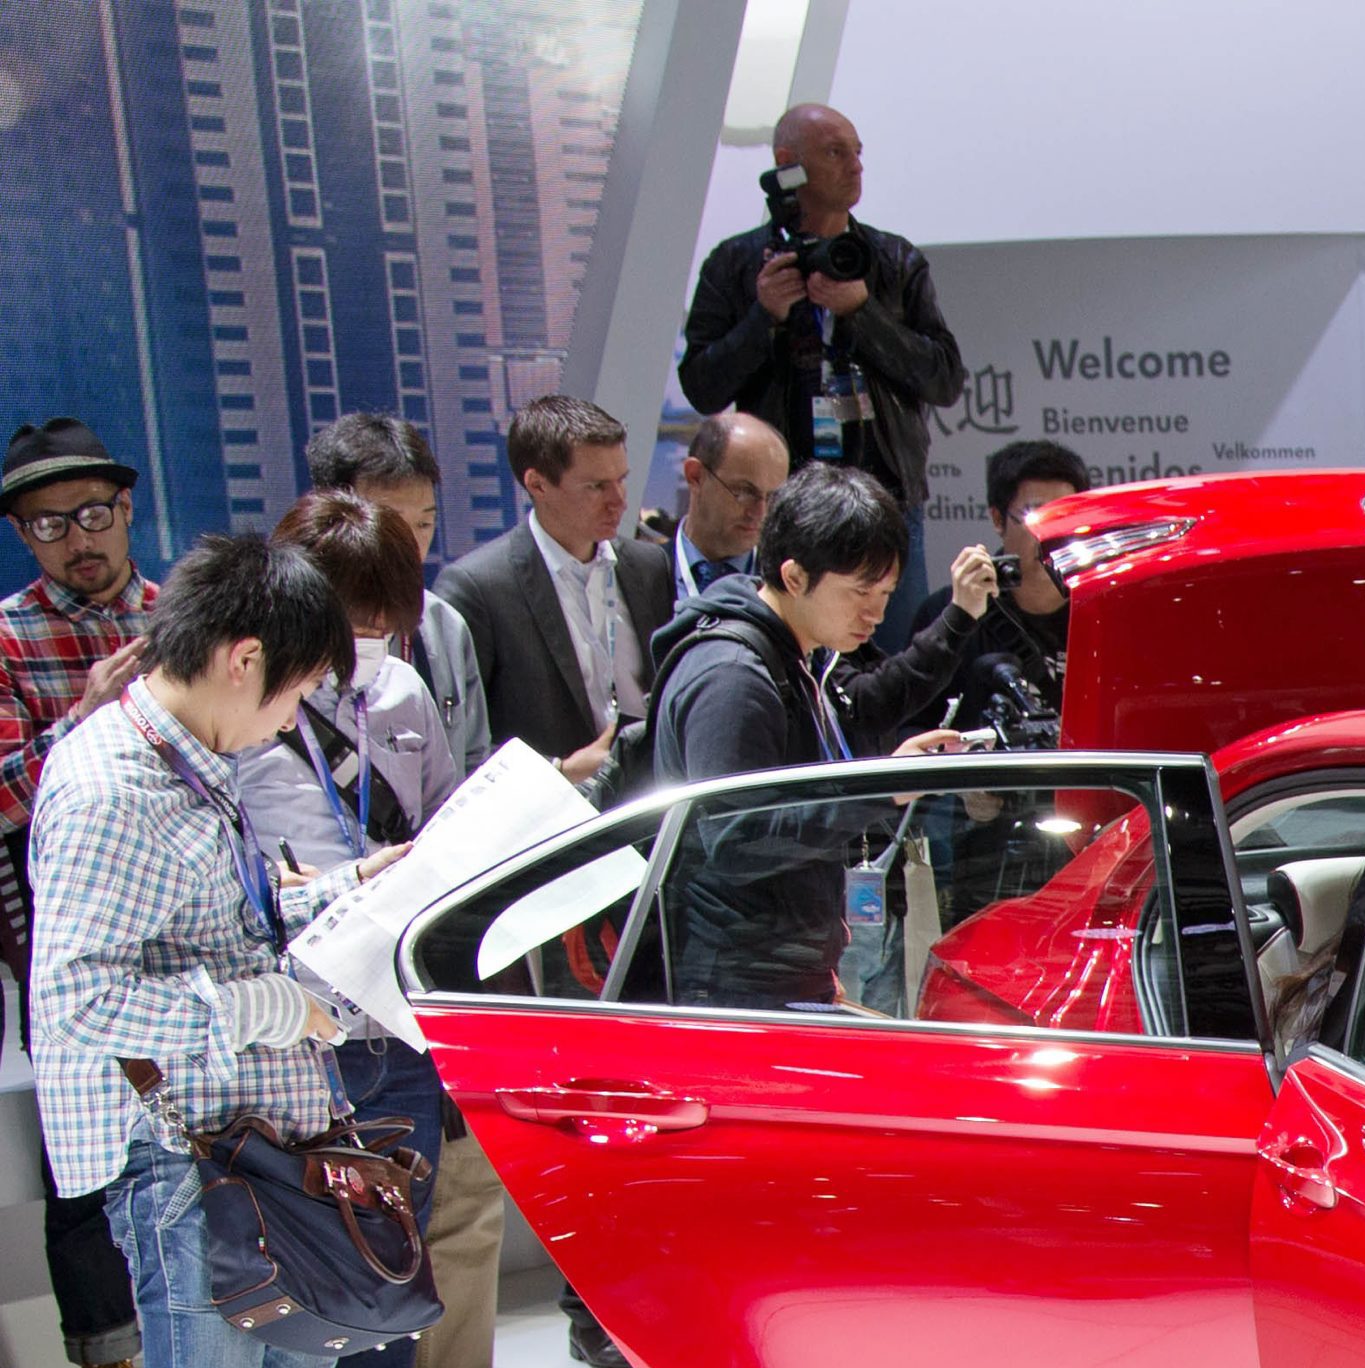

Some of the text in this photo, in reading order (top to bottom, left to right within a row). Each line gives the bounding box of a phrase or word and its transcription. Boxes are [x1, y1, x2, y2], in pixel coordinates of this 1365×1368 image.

[1032, 336, 1231, 380] Welcome
[1042, 407, 1189, 435] Bienvenue
[1213, 442, 1316, 461] Velkommen
[1087, 450, 1203, 487] enidos
[927, 494, 989, 521] diniz
